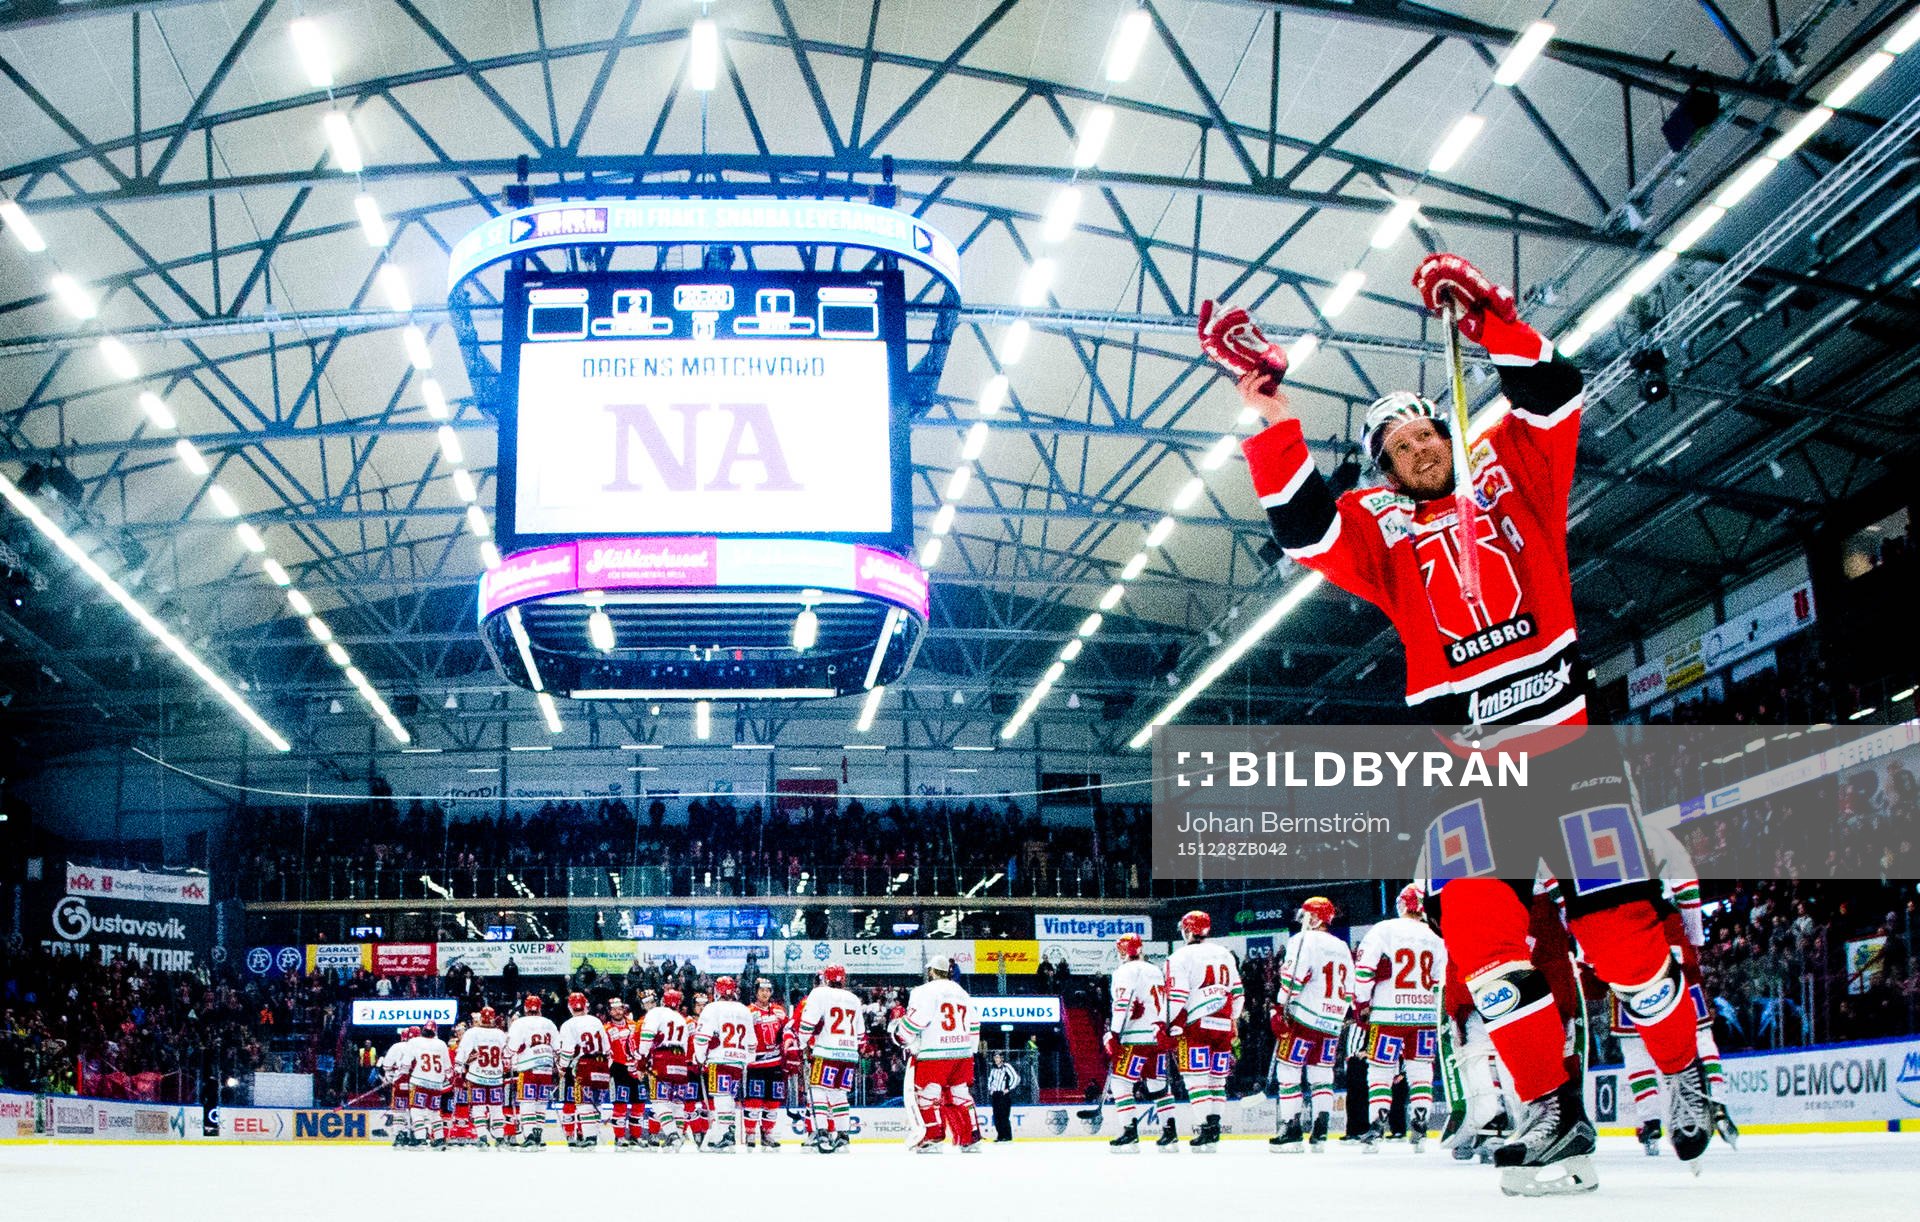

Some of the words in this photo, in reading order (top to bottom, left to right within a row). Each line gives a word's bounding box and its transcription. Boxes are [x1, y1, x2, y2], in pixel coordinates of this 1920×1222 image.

[583, 357, 673, 378] DAGENS
[602, 403, 804, 493] NA
[1452, 619, 1531, 663] ÖREBRO
[1571, 775, 1623, 791] EASTON
[52, 896, 186, 941] Gustavsvik
[1043, 917, 1145, 938] Vintergatan
[843, 942, 878, 956] Let's
[986, 952, 1029, 962] DHL
[378, 1009, 450, 1020] ASPLUNDS
[830, 1006, 856, 1036] 27
[940, 1002, 967, 1032] 37
[982, 1007, 1054, 1018] ASPLUNDS
[667, 1020, 684, 1042] 11
[721, 1022, 746, 1049] 22
[580, 1031, 601, 1055] 31
[420, 1053, 442, 1074] 35
[477, 1045, 501, 1068] 58
[1775, 1057, 1887, 1097] DEMCOM
[234, 1117, 270, 1133] EEL
